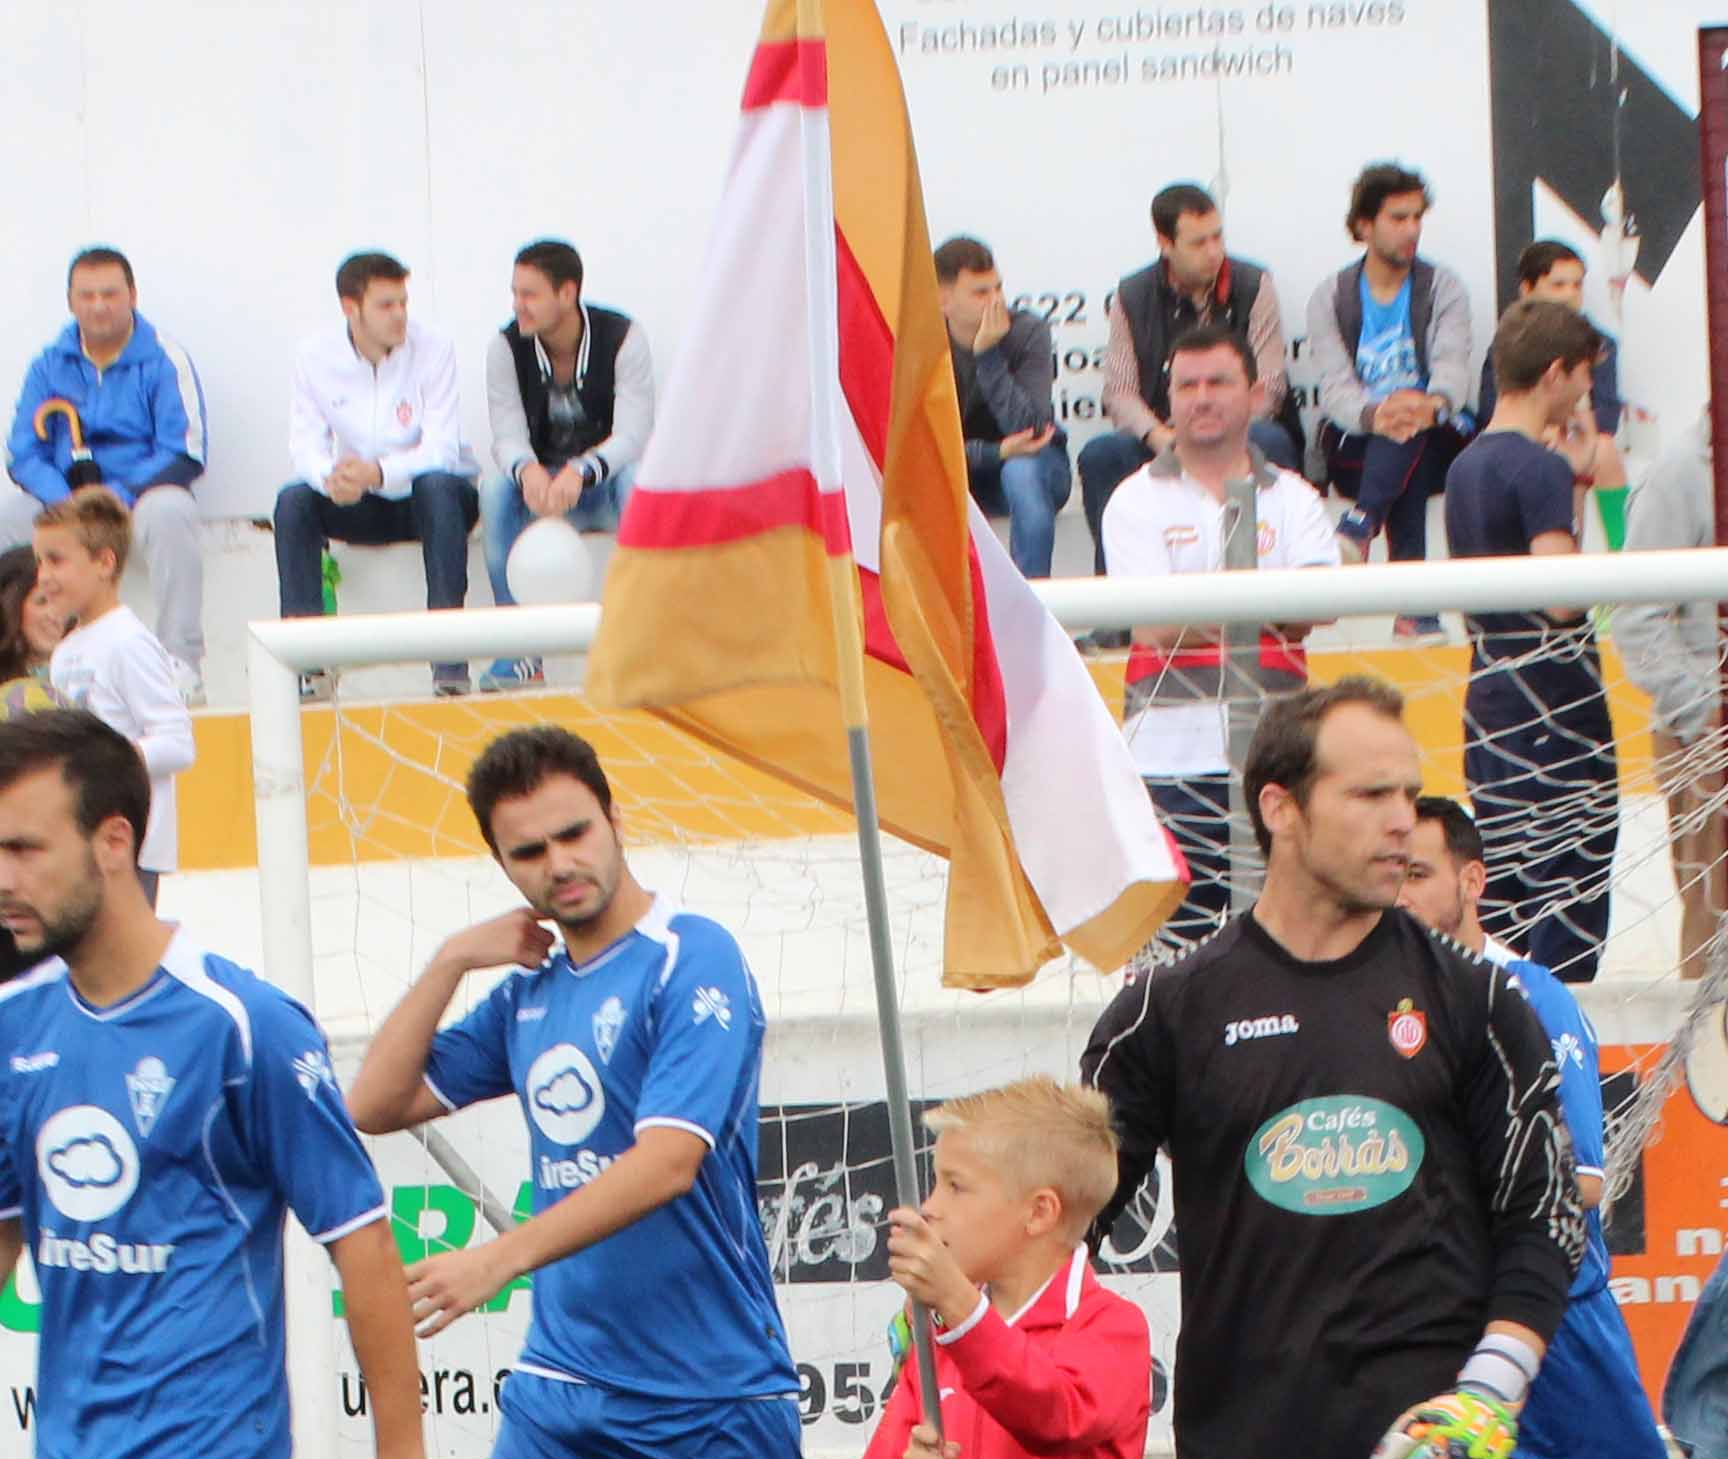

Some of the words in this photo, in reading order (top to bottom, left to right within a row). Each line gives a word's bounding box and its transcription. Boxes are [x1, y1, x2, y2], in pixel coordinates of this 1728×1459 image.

[898, 16, 1057, 55] Fachadas
[1068, 19, 1086, 52] y
[1096, 7, 1246, 44] cubiertas
[1256, 1, 1297, 34] de
[1306, 0, 1406, 29] naves
[990, 63, 1030, 93] en
[1041, 50, 1131, 95] panel
[1140, 42, 1296, 83] sandwich
[1306, 1105, 1377, 1133] Cafés
[1258, 1111, 1410, 1184] Borrás
[38, 1226, 177, 1275] ireSur
